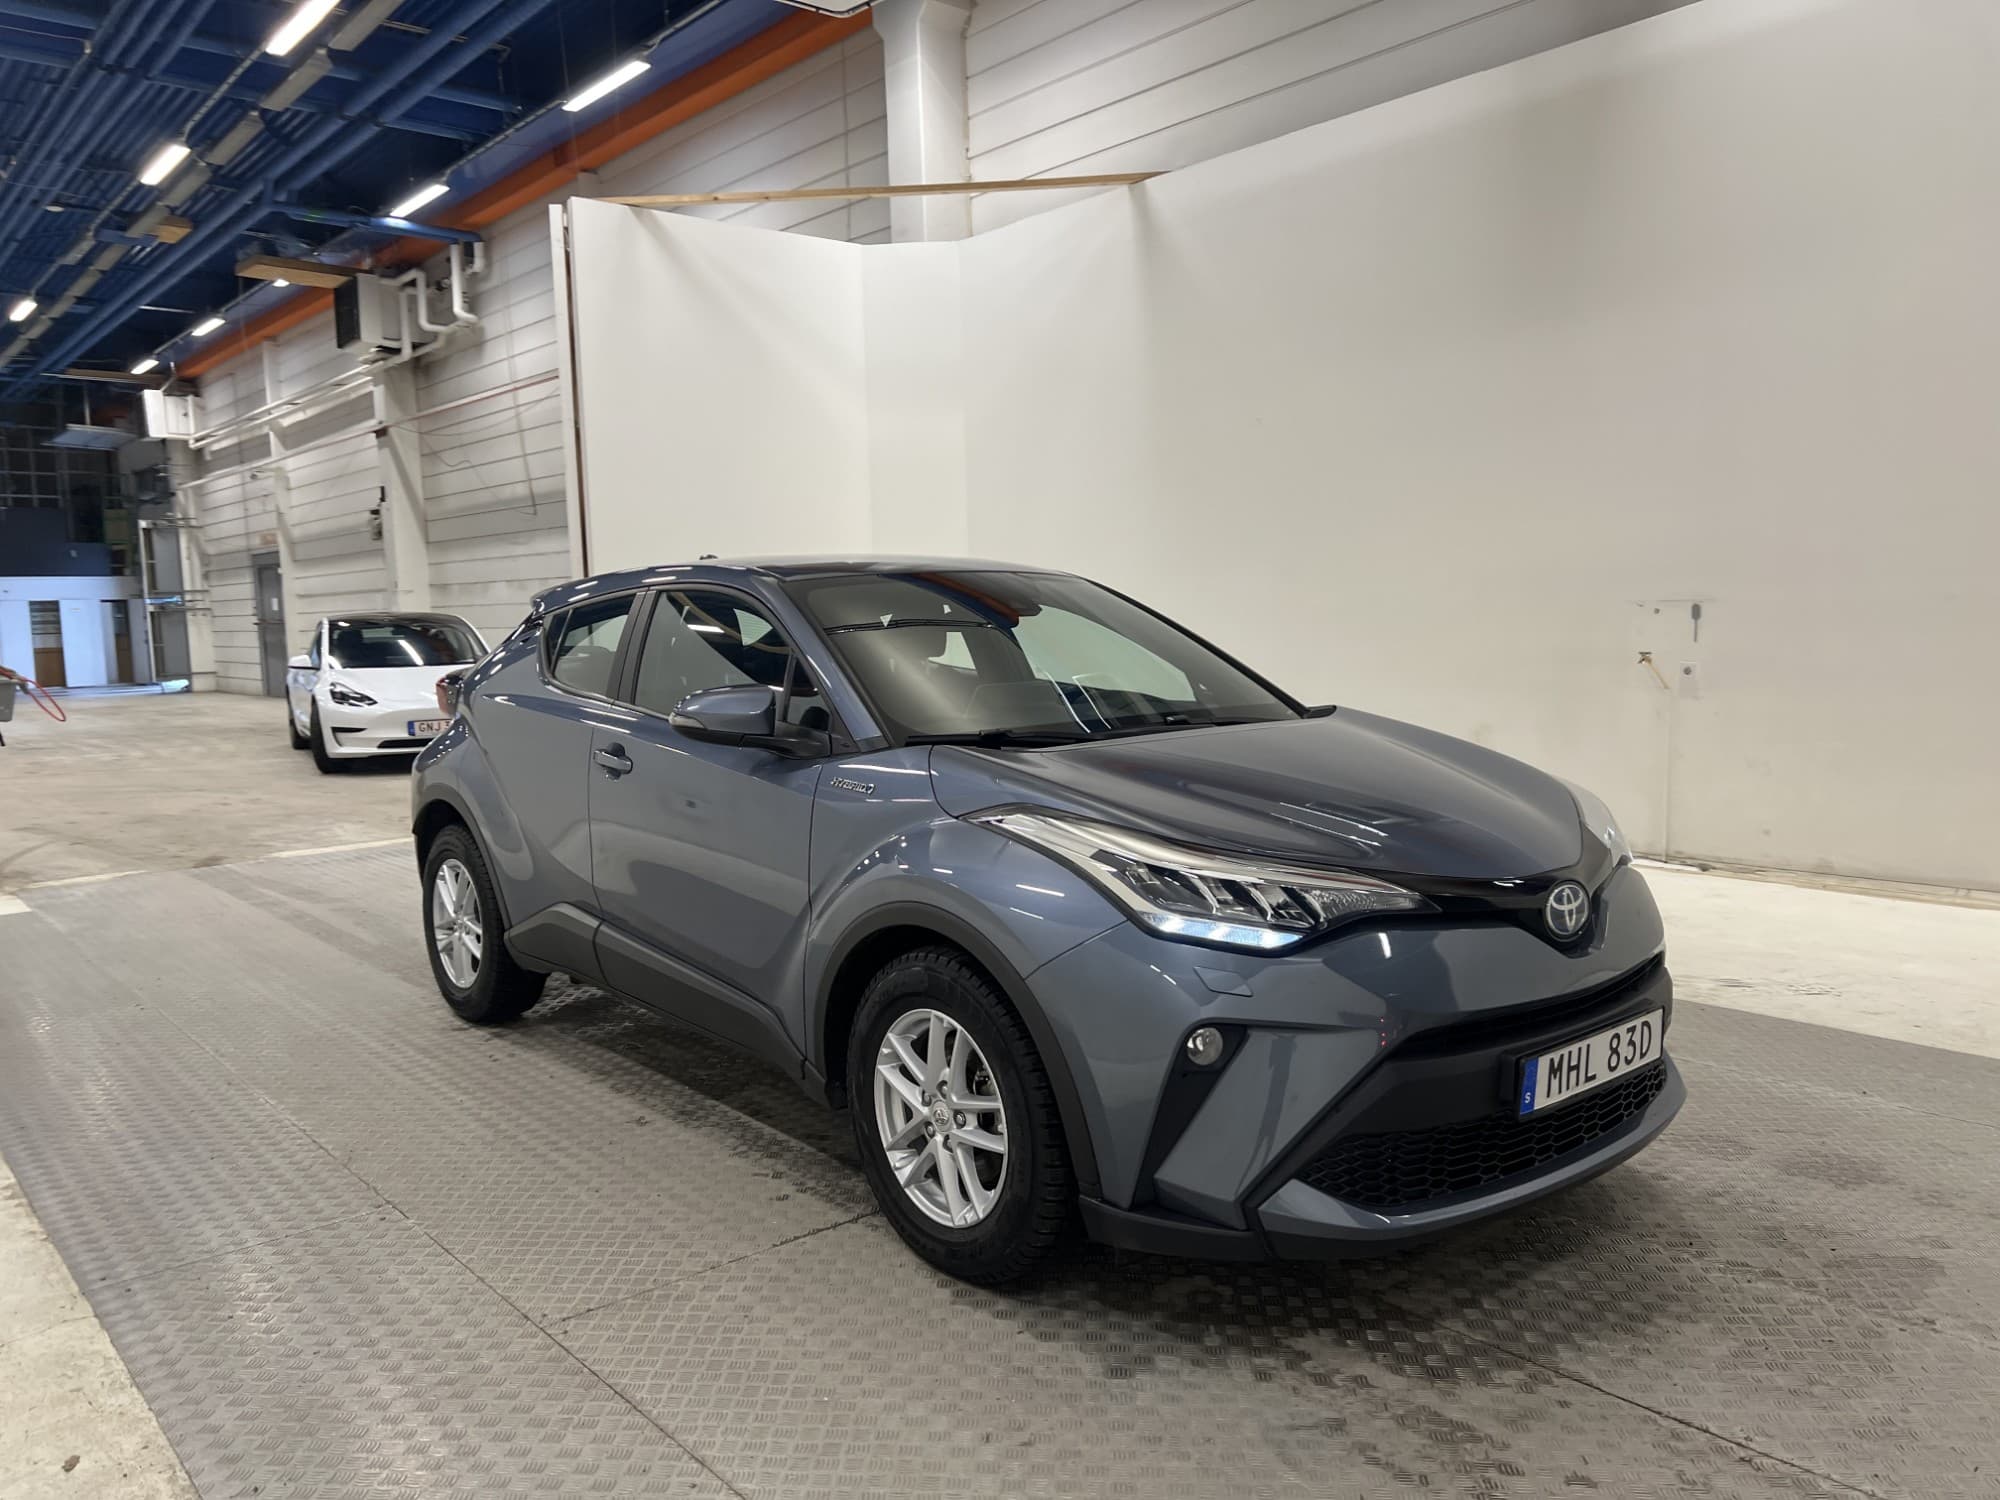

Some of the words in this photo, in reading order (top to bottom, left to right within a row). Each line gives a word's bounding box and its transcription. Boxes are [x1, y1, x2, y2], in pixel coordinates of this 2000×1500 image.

[418, 722, 441, 732] GNJ
[1547, 1043, 1597, 1098] MHL
[1607, 1020, 1652, 1073] 83D
[1524, 1091, 1531, 1104] S
